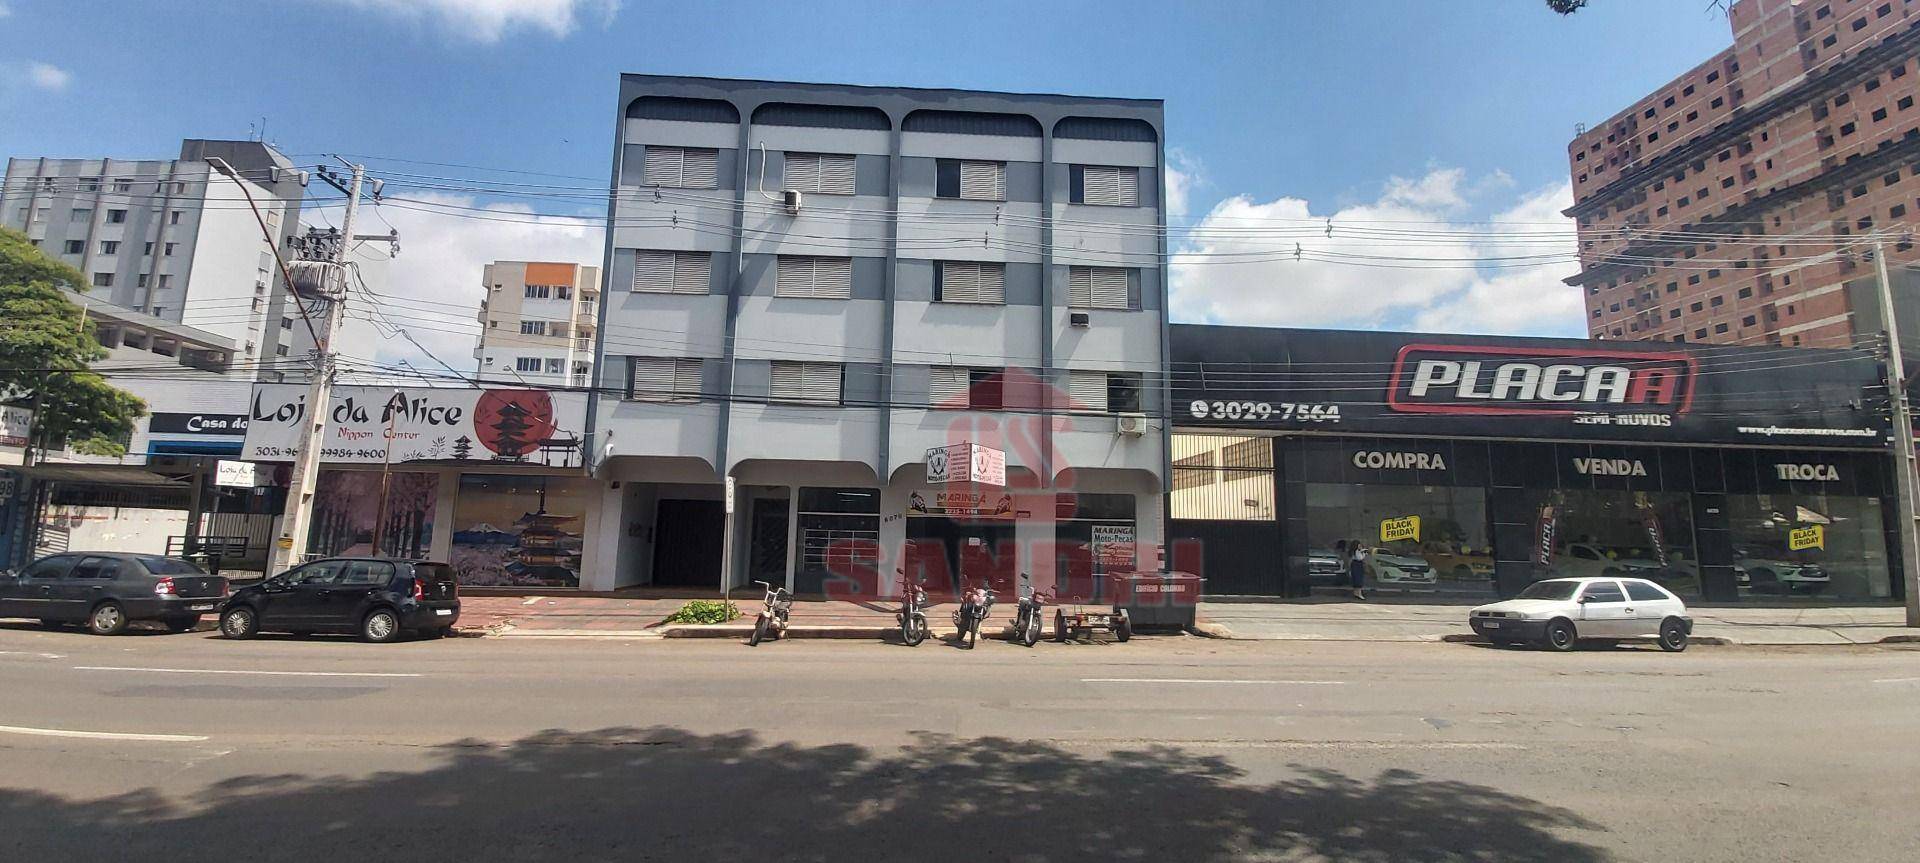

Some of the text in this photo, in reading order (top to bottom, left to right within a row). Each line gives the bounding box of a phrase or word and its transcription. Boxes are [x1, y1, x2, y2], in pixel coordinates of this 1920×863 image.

[252, 388, 463, 429] Loj da Alice
[1211, 400, 1341, 423] 3029-7564
[187, 415, 227, 432] Casa
[338, 426, 374, 441] Nippon
[255, 446, 298, 457] 3031-96
[1353, 450, 1447, 470] COMPRA
[1572, 457, 1648, 477] VENDA
[1775, 463, 1840, 481] TROCA
[1386, 520, 1412, 530] BLACK
[1386, 527, 1415, 538] FRIDAY
[1793, 529, 1817, 540] BLACK
[1795, 537, 1819, 547] FRIDAY
